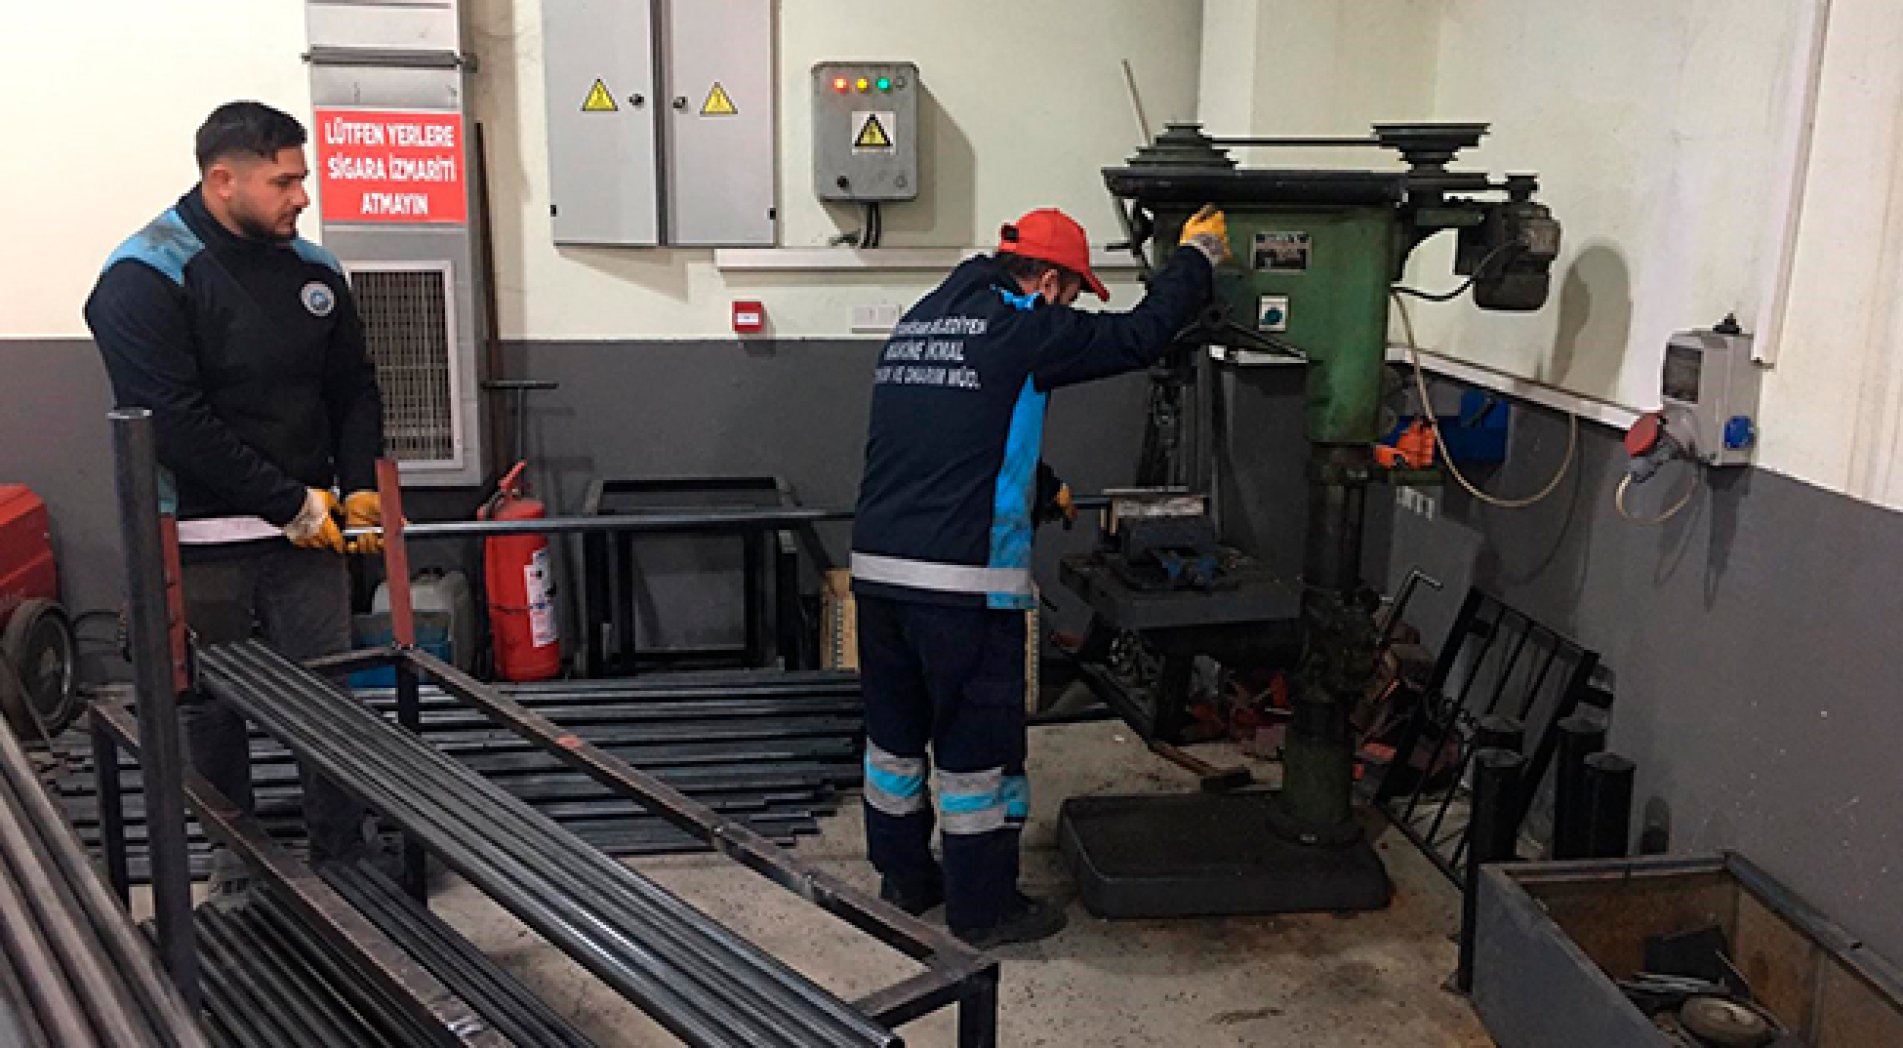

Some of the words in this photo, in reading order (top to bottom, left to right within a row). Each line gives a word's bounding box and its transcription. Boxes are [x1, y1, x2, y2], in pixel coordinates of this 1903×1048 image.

[325, 117, 384, 146] LÜTFEN
[387, 123, 454, 147] YERLERE
[328, 152, 386, 180] SİGARA
[389, 152, 457, 182] İZMARİTİ
[360, 193, 428, 215] ATMAYIN
